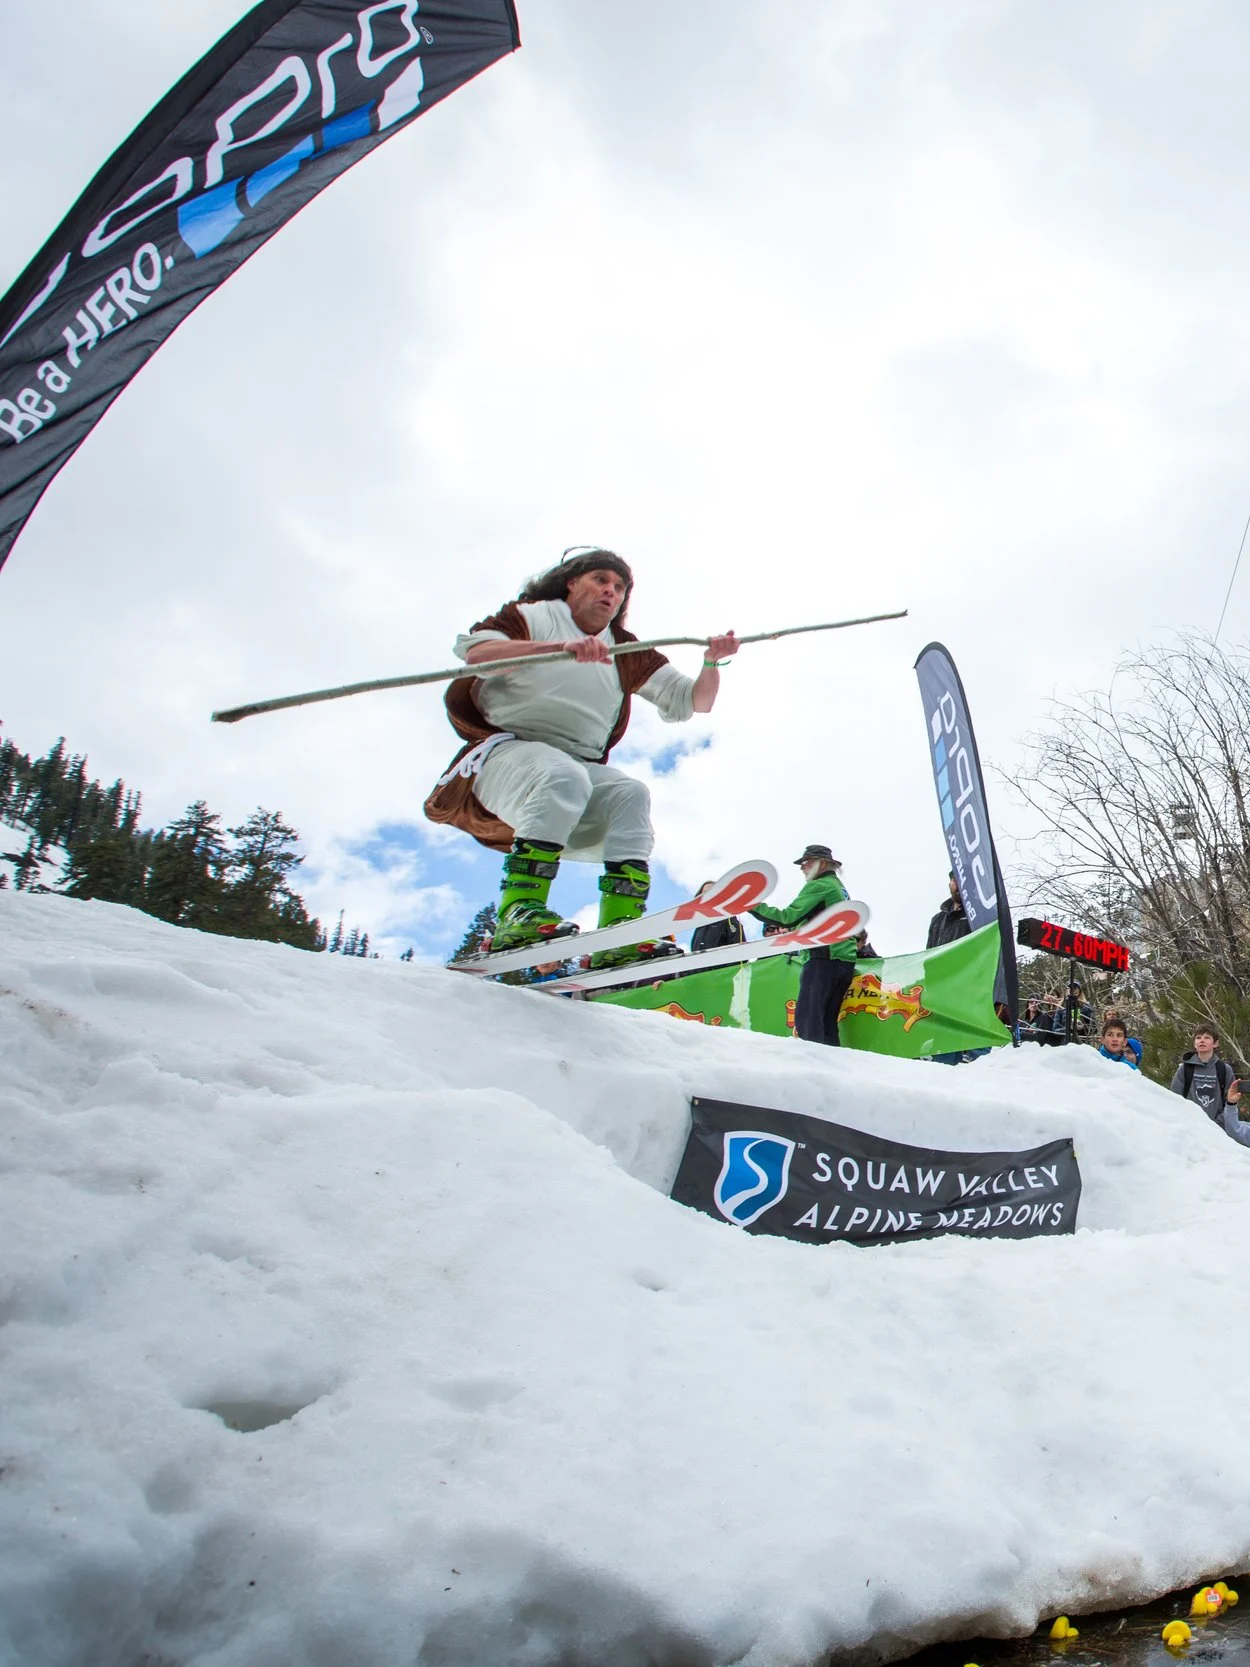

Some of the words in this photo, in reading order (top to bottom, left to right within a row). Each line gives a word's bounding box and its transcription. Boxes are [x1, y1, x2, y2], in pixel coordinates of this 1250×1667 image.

[0, 388, 57, 444] Be
[37, 360, 72, 394] a
[62, 242, 175, 369] HERO.
[673, 871, 768, 921] K2
[812, 1152, 946, 1197] SQUAW
[957, 1164, 1059, 1198] VALLEY
[793, 1202, 922, 1233] ALPINE
[932, 1202, 1064, 1230] MEADOWS
